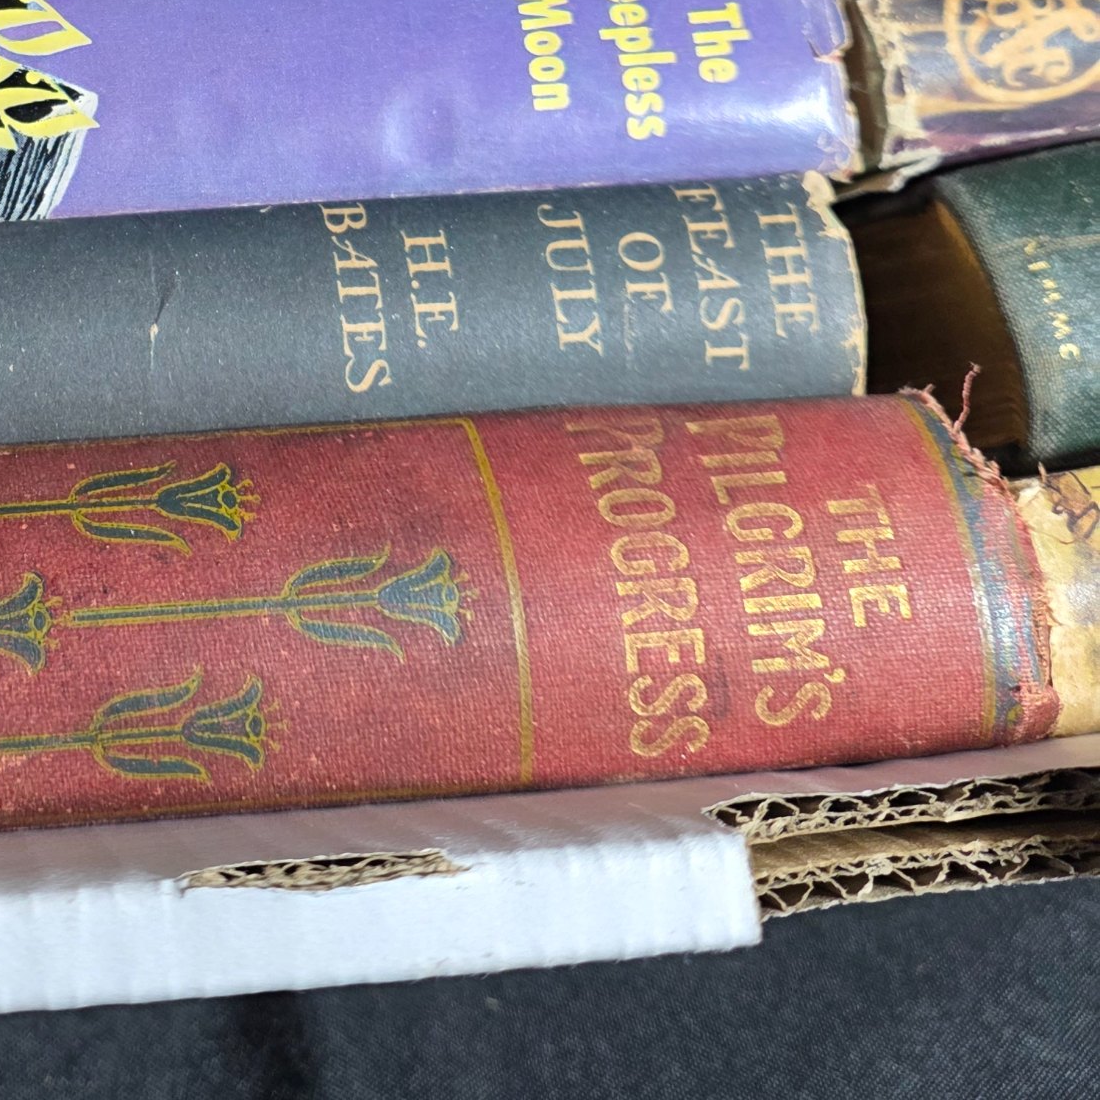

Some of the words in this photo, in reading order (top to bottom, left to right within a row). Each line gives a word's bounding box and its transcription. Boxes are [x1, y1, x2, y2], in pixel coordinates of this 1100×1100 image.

[687, 2, 753, 84] The
[318, 202, 393, 393] BATES
[537, 204, 603, 357] JULY
[617, 231, 675, 314] OF
[669, 182, 750, 371] FEAST
[754, 202, 821, 339] THE
[565, 415, 711, 759] PROGRESS
[685, 412, 845, 728] PILGRIM'S
[825, 483, 913, 628] THE
